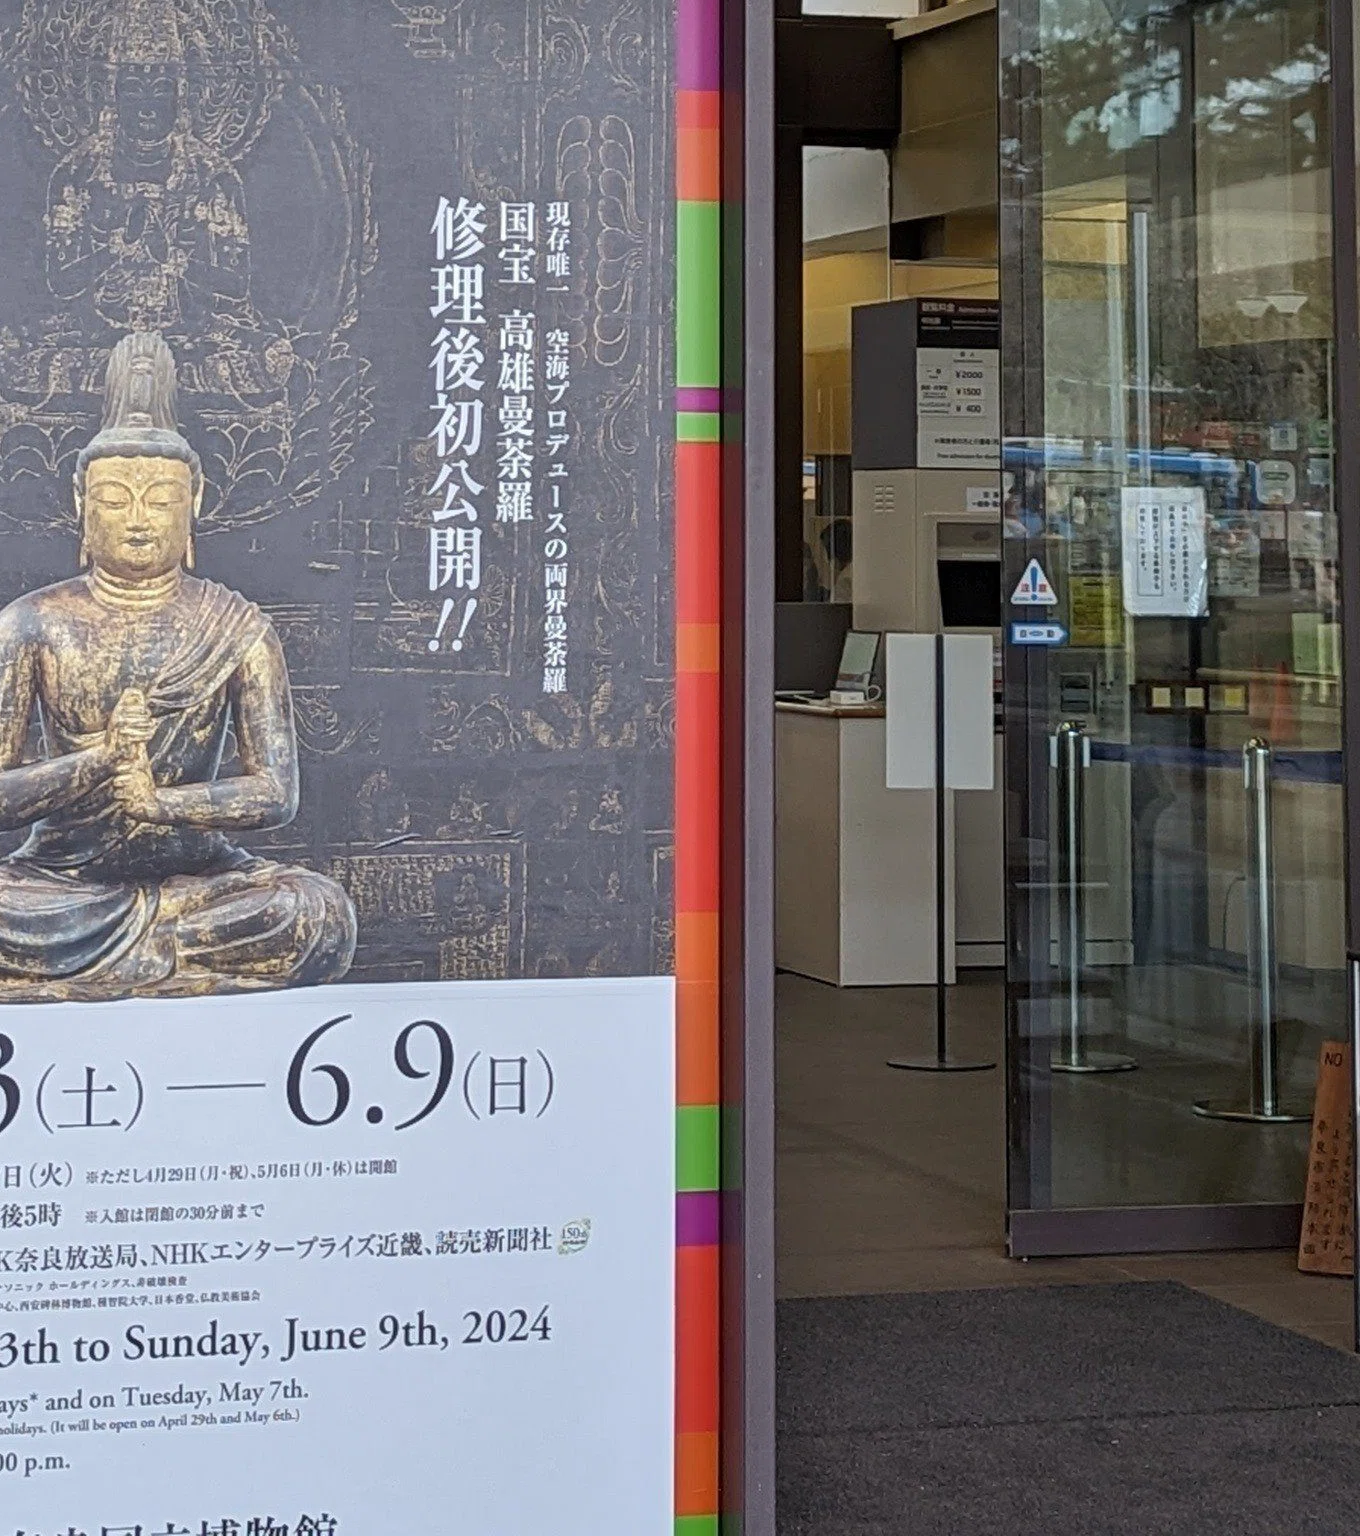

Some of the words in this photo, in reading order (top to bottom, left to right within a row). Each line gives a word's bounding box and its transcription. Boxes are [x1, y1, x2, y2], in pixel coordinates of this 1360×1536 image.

[497, 200, 536, 286] 国宝
[545, 201, 571, 293] 現存唯一
[427, 196, 487, 652] 修理後初公開!!
[495, 310, 535, 523] 高雄曼荼羅
[73, 1336, 110, 1363] to
[123, 1319, 270, 1367] Sunday,
[280, 1317, 367, 1363] June
[378, 1309, 449, 1351] 9th,
[461, 1304, 552, 1344] 2024
[45, 1388, 83, 1411] and
[88, 1394, 116, 1409] on
[120, 1383, 212, 1410] Tuesday,
[218, 1381, 265, 1407] May
[269, 1377, 309, 1402] 7th.
[50, 1420, 66, 1435] (It
[67, 1418, 90, 1432] will
[92, 1418, 107, 1431] be
[108, 1420, 138, 1434] open
[140, 1419, 156, 1429] on
[157, 1413, 188, 1431] April
[190, 1412, 218, 1426] 29th
[219, 1410, 242, 1425] and
[243, 1410, 271, 1426] May
[272, 1407, 301, 1423] 6th.)
[23, 1456, 71, 1478] p.m.
